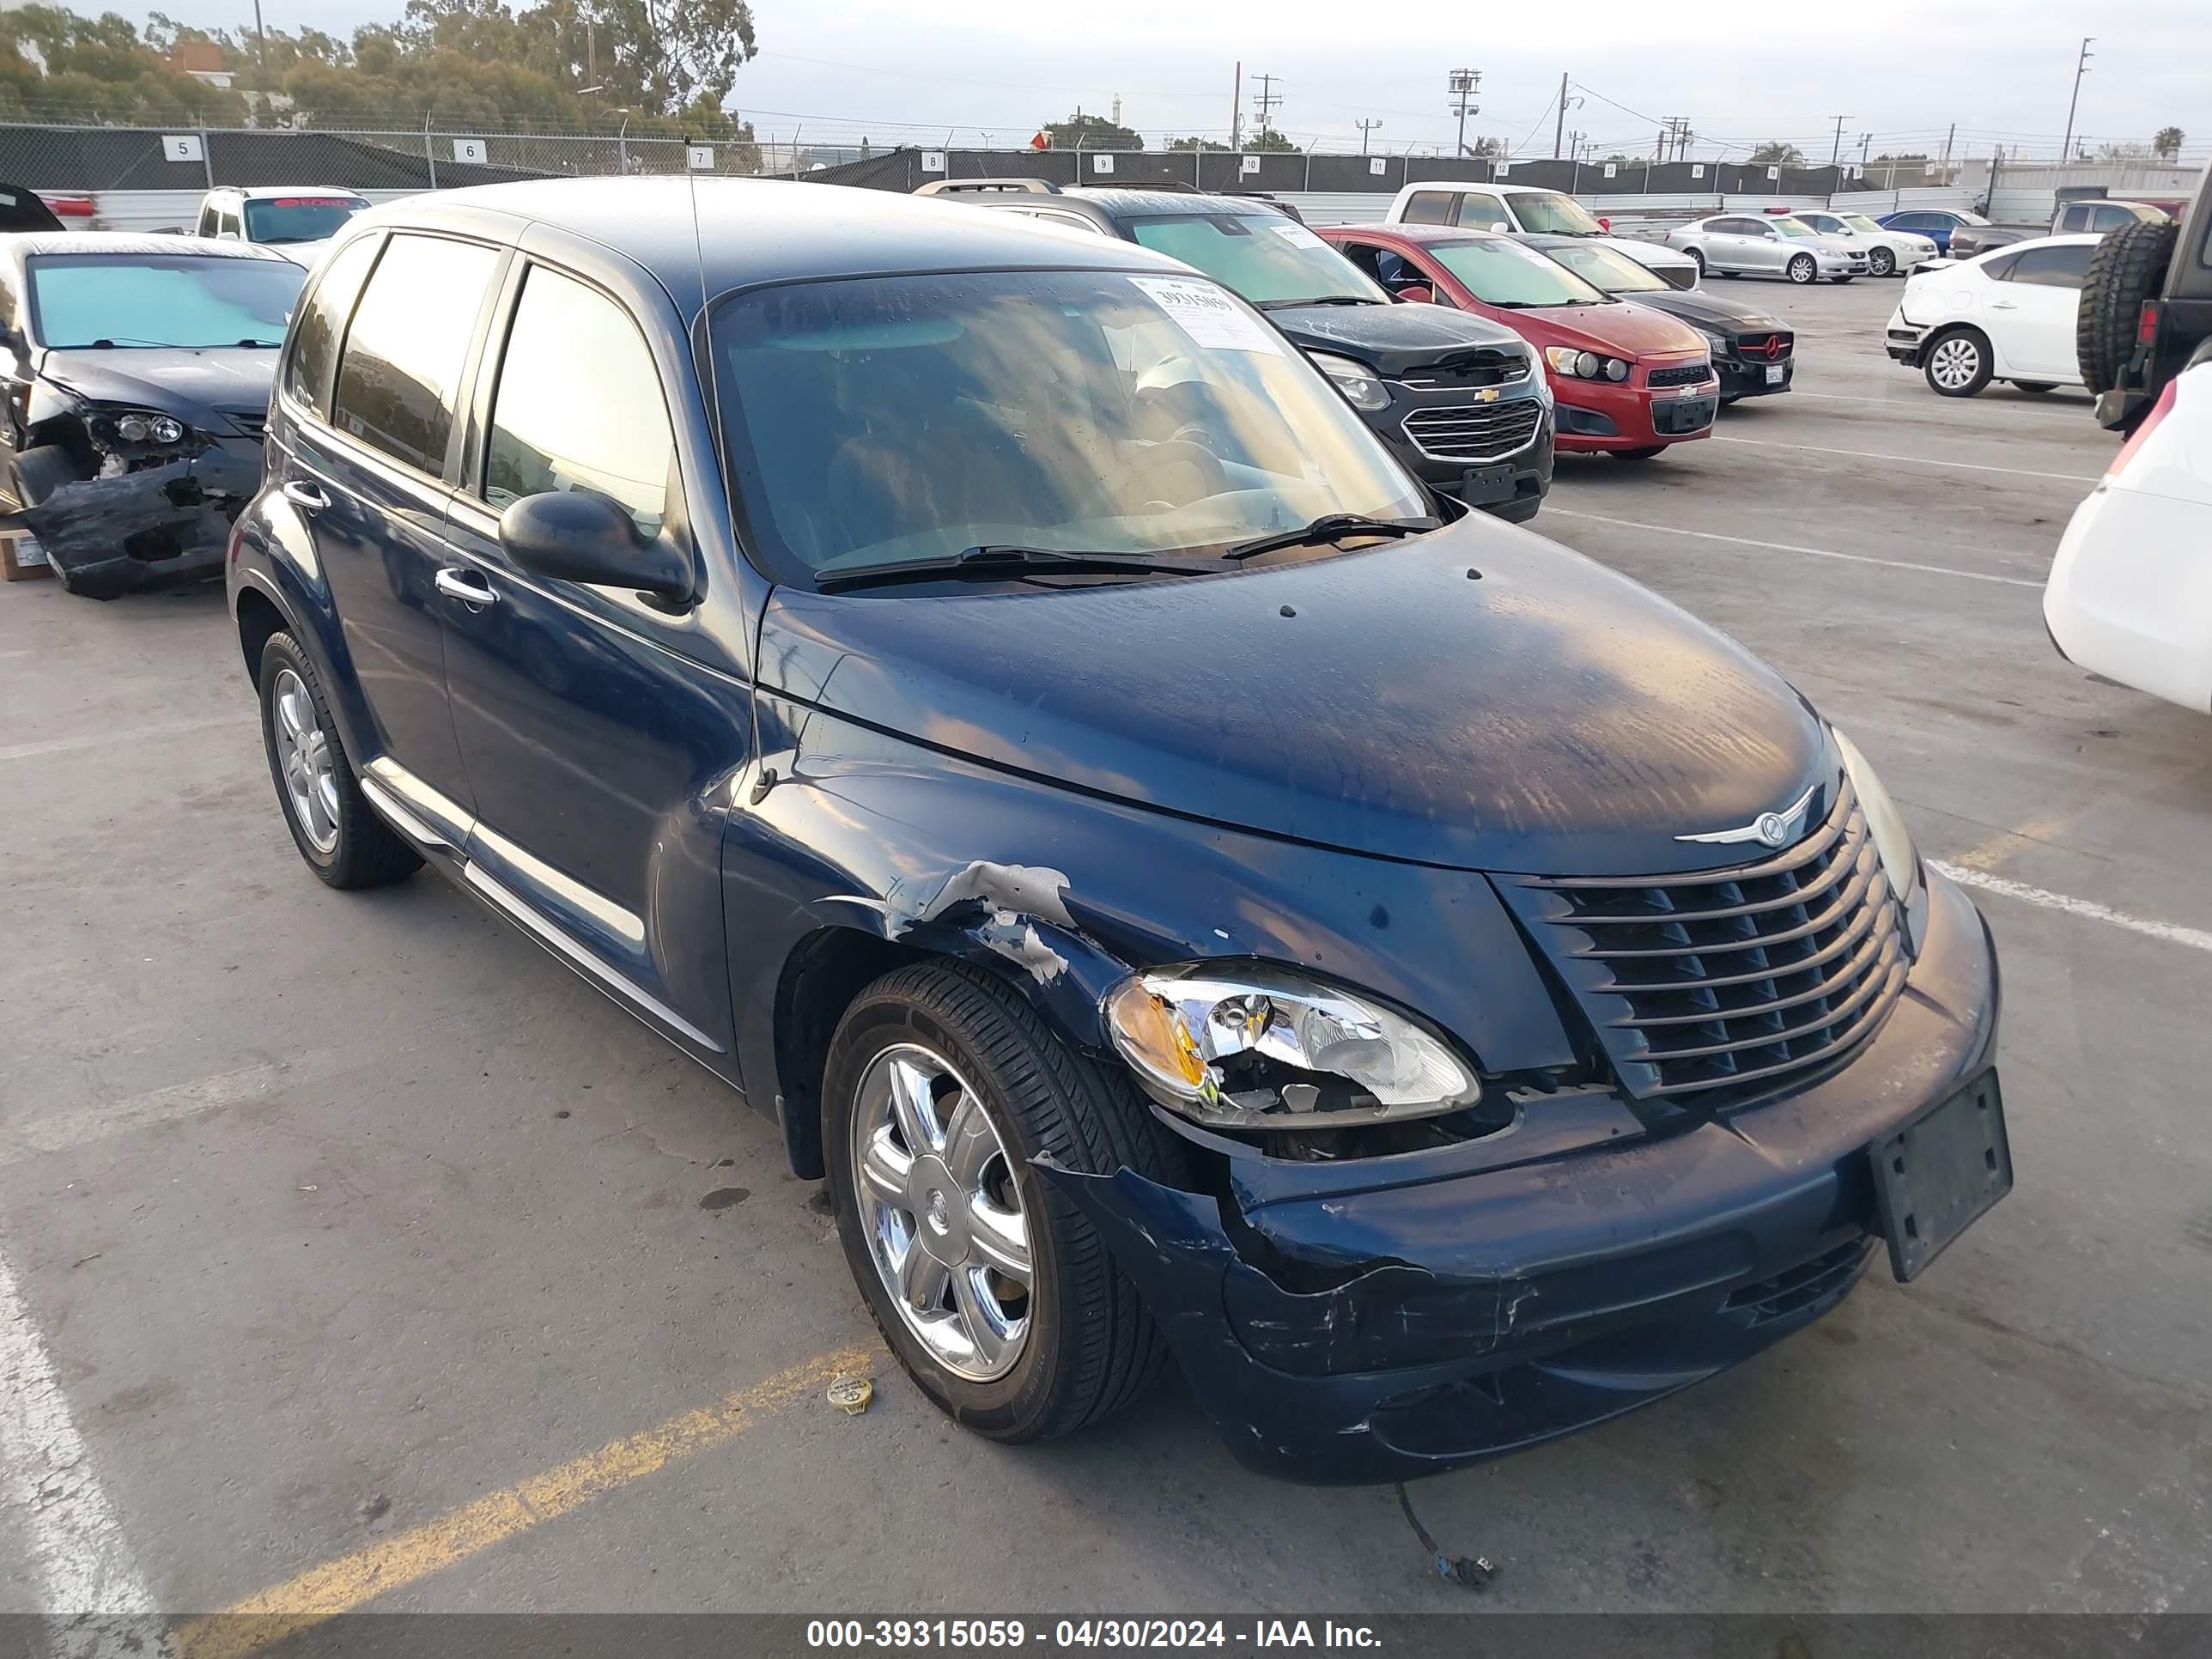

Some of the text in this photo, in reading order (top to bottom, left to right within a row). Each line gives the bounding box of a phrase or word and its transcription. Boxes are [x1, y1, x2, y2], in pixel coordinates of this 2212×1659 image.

[179, 143, 189, 155] 5
[466, 145, 475, 157] 6
[696, 153, 704, 163] 7
[930, 157, 937, 167] 8
[1101, 160, 1107, 169] 9
[1247, 160, 1256, 169] 10
[1374, 162, 1382, 171] 11
[1498, 164, 1506, 173] 12
[1607, 167, 1613, 175] 13
[1156, 291, 1232, 311] 39315059
